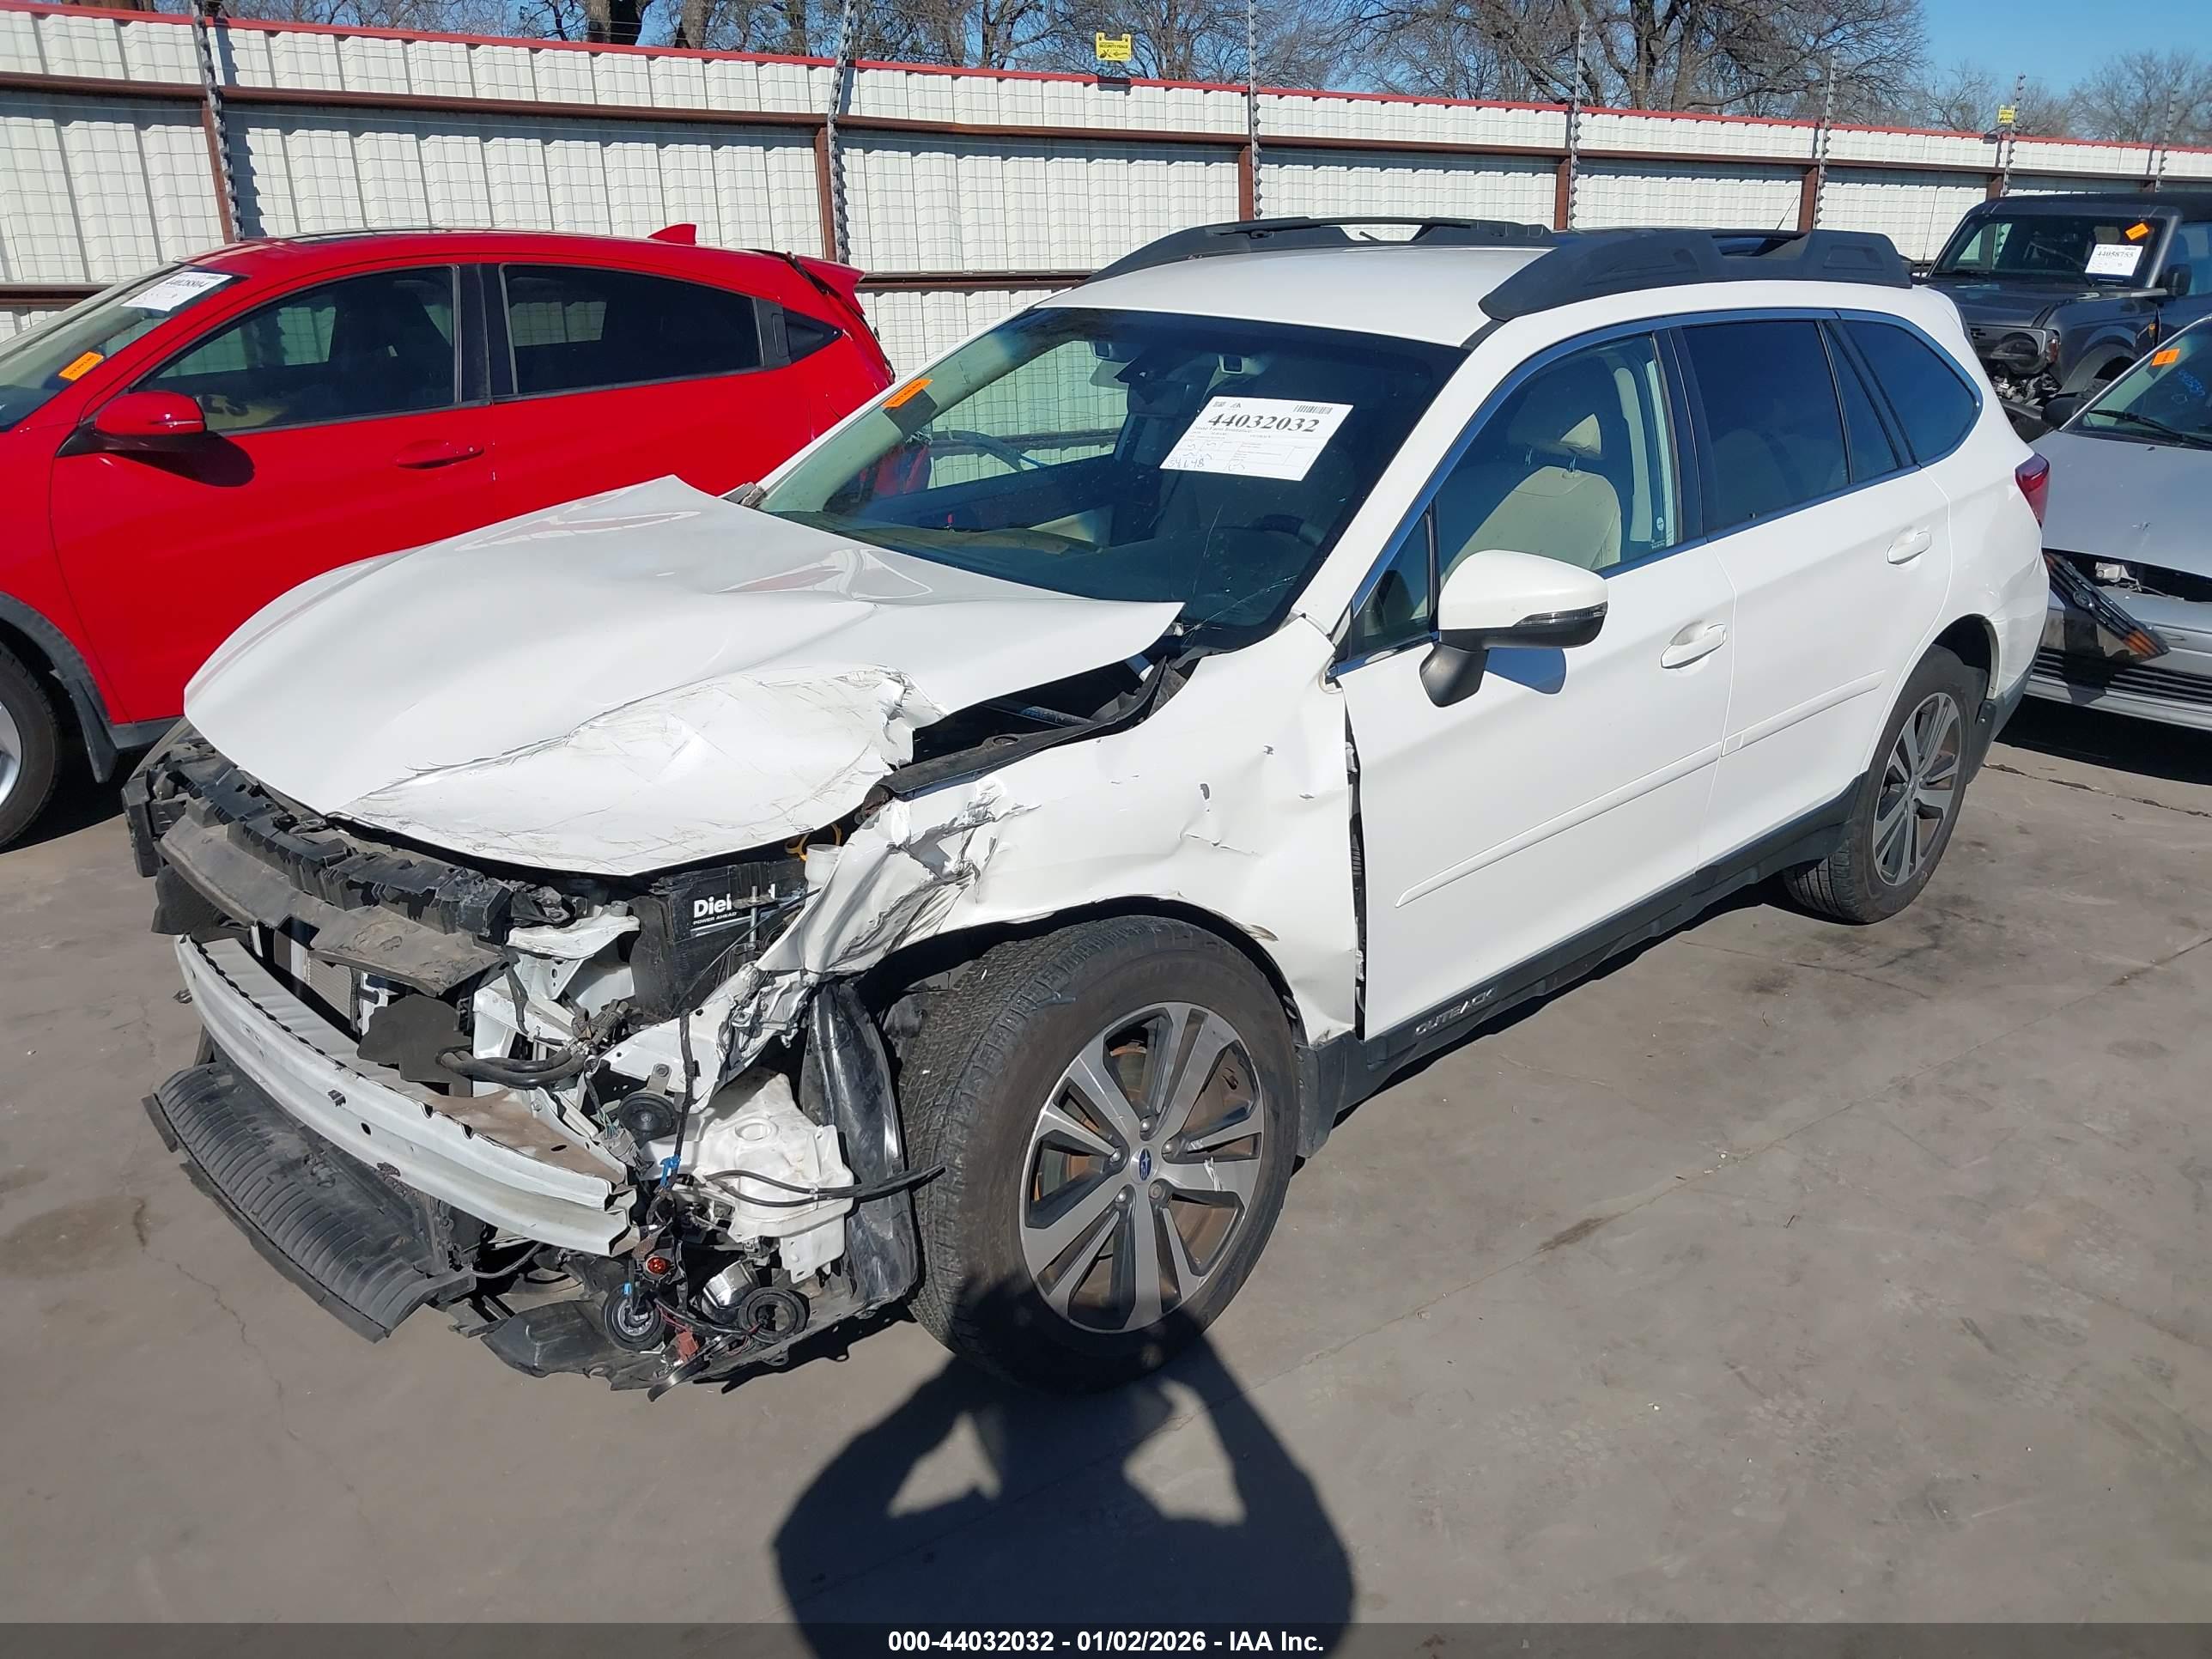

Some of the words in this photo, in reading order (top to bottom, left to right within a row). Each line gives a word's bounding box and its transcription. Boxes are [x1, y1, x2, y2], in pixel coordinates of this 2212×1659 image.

[1207, 413, 1320, 433] 44032032
[692, 916, 715, 926] POWER
[715, 911, 738, 921] AHEAD
[1414, 987, 1497, 1036] OUTBACK
